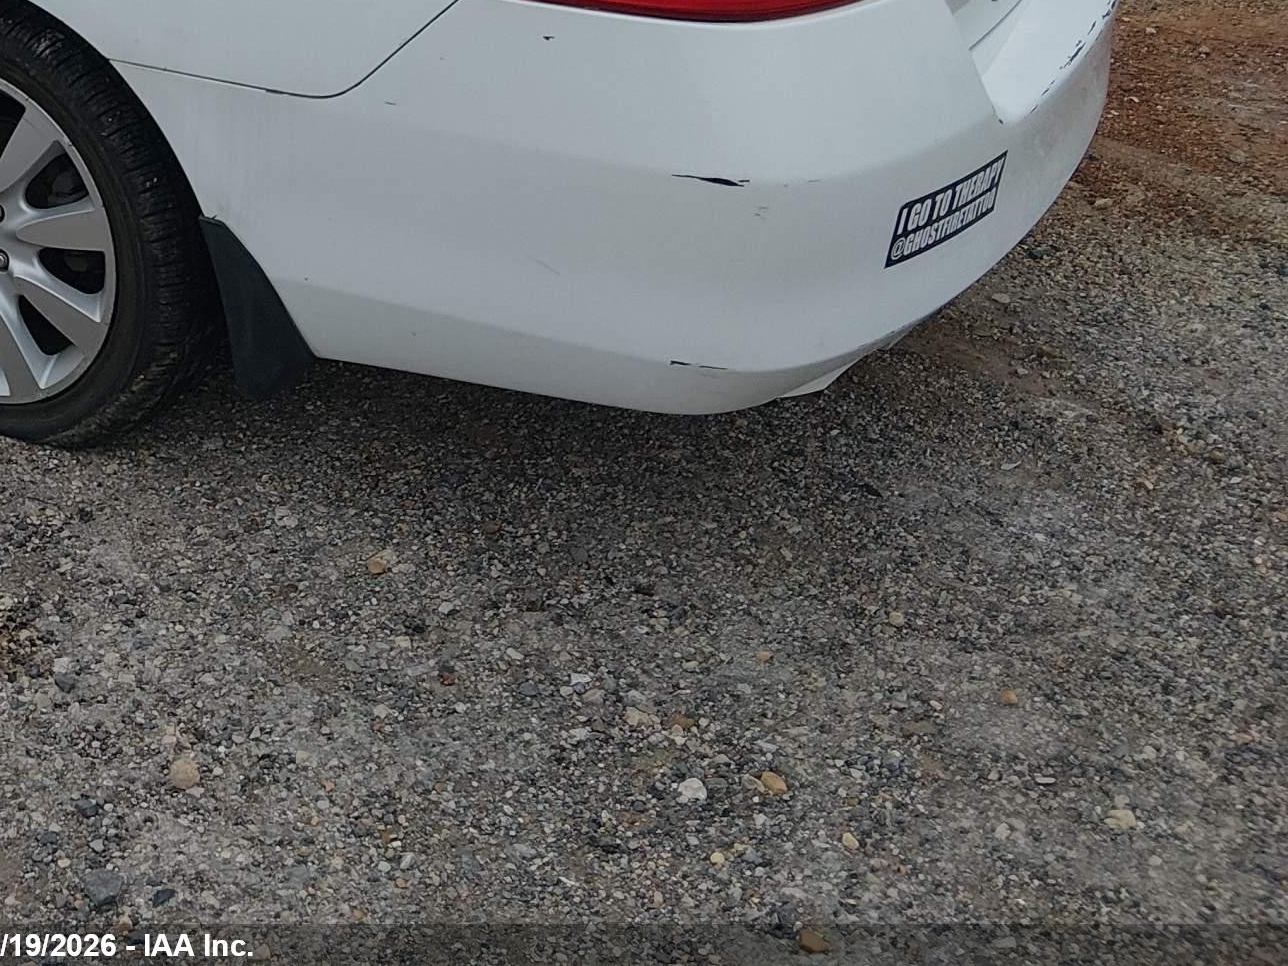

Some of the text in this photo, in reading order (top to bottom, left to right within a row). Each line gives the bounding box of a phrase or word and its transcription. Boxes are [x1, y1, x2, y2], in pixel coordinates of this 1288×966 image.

[897, 156, 1005, 235] I GO TO THERAPY
